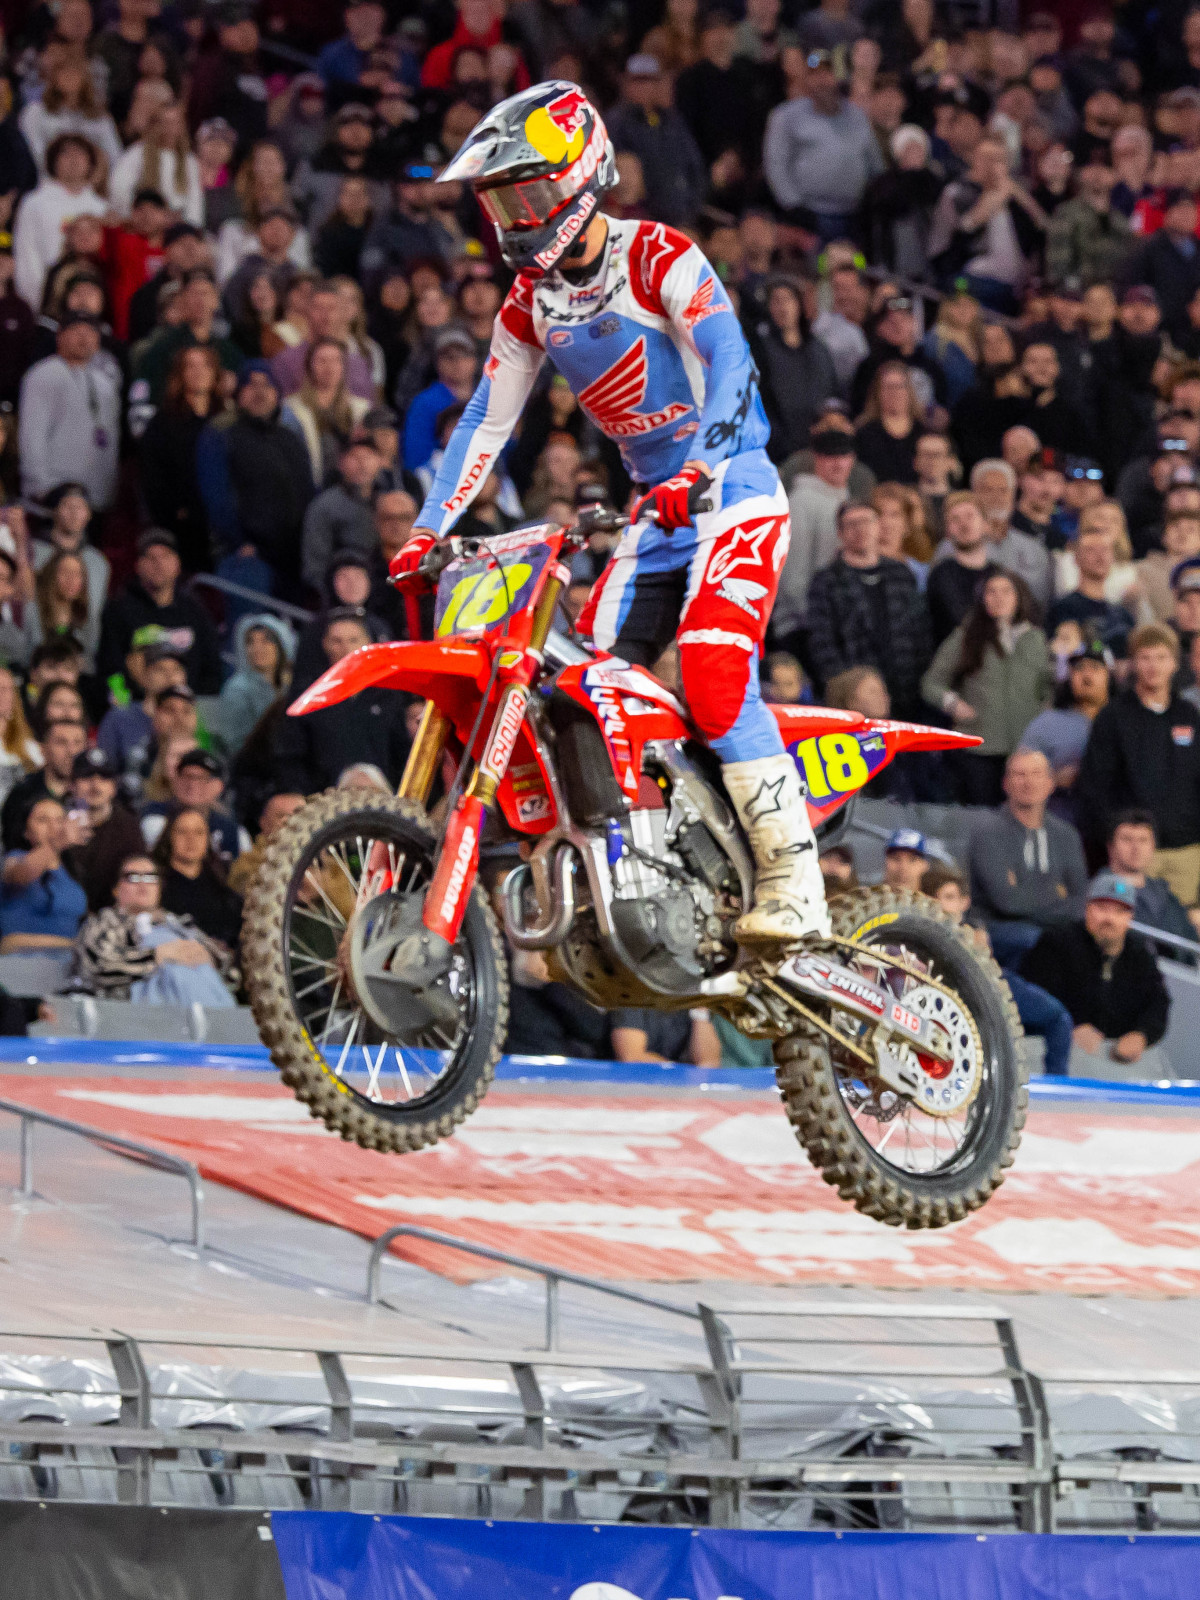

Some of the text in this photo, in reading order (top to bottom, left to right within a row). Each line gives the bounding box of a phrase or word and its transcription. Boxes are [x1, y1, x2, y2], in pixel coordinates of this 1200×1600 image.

[443, 452, 491, 512] HONDA
[438, 563, 533, 638] 18
[491, 692, 525, 773] SHOWA
[590, 688, 626, 736] CRF
[797, 733, 870, 799] 18
[440, 825, 476, 924] DUNLOP
[893, 1005, 920, 1031] DID
